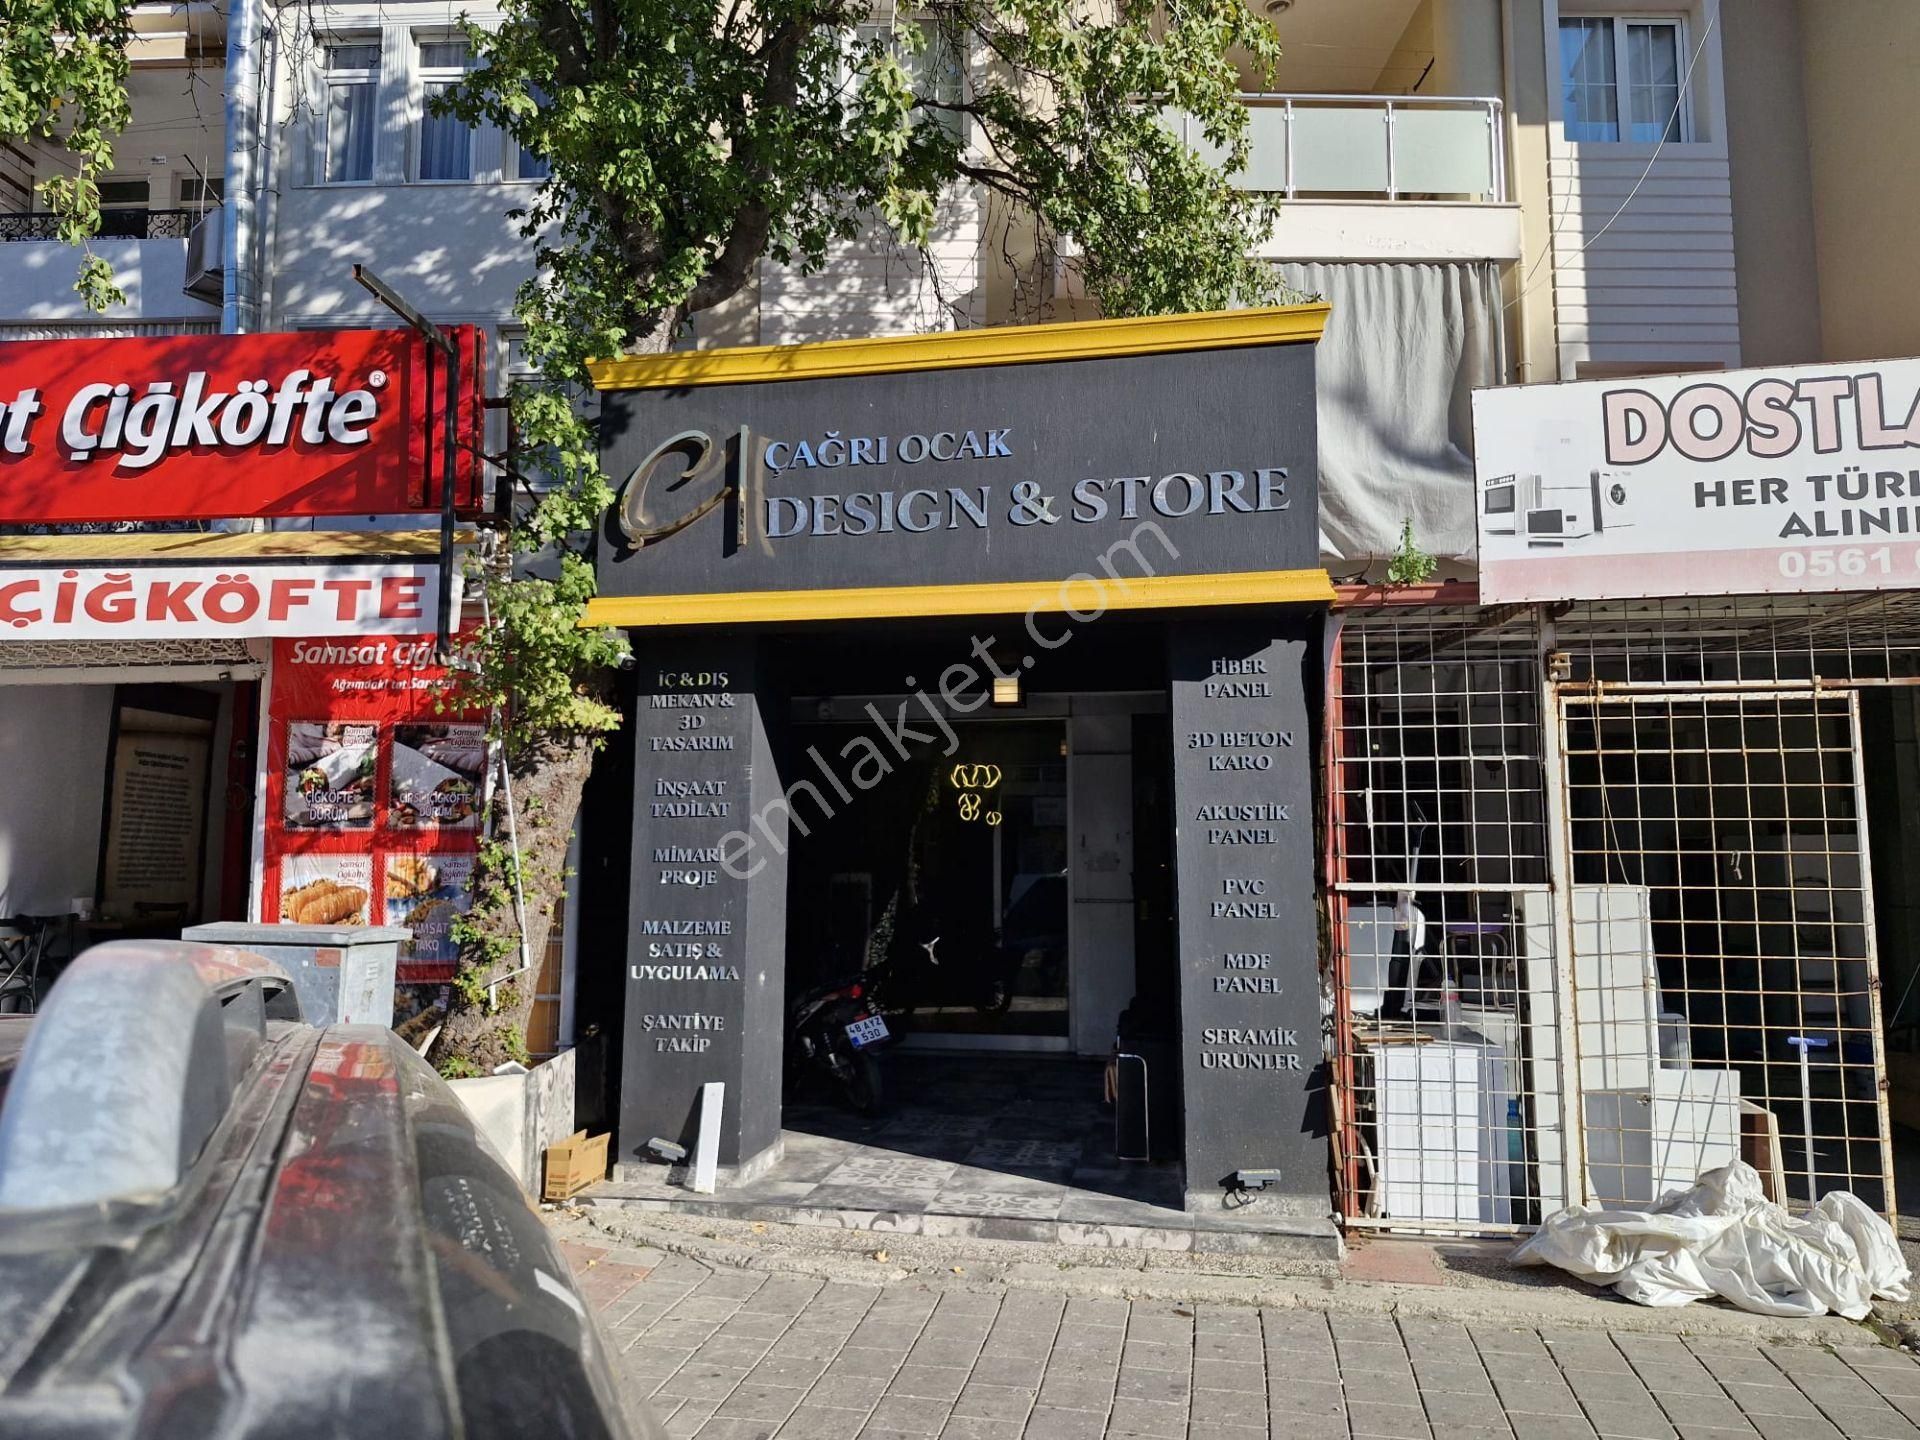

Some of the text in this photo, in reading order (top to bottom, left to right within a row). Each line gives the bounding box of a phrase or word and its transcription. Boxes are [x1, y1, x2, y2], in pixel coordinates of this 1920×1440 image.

[1602, 372, 1920, 465] DOSTL
[764, 428, 1013, 477] ÇAĞRI OCAK
[1695, 478, 1789, 507] HER
[765, 467, 1291, 538] DESIGN & STORE
[1779, 506, 1920, 538] ALINI
[1779, 547, 1892, 578] 0561
[0, 570, 427, 628] ÇİĞKÖFTE
[290, 641, 388, 665] Samsat
[1211, 657, 1267, 674] FİBER
[659, 670, 729, 689] İÇ & DIŞ
[1205, 682, 1273, 698] PANEL
[651, 692, 736, 708] MEKAN &
[679, 714, 705, 730] 3D
[651, 736, 734, 751] TASARIM
[1188, 732, 1294, 748] 3D BETON
[1210, 755, 1273, 770] KARO
[656, 778, 726, 798] İNŞAAT
[652, 800, 731, 817] TADİLAT
[1197, 803, 1289, 821] AKUSTİK
[1209, 829, 1278, 844] PANEL
[654, 845, 725, 863] MİMARİ
[660, 870, 718, 888] PROJE
[1224, 879, 1266, 895] PVC
[1212, 902, 1280, 918] PANEL
[642, 920, 731, 936] MALZEME
[649, 943, 722, 960] SATIŞ &
[1225, 953, 1271, 969] MDF
[631, 965, 739, 980] UYGULAMA
[1215, 977, 1283, 993] PANEL
[642, 1013, 724, 1031] ŞANTİYE
[861, 1028, 881, 1041] 530
[1203, 1027, 1298, 1046] SERAMİK
[656, 1034, 711, 1053] TAKİP
[1201, 1048, 1302, 1070] ÜRÜNLER
